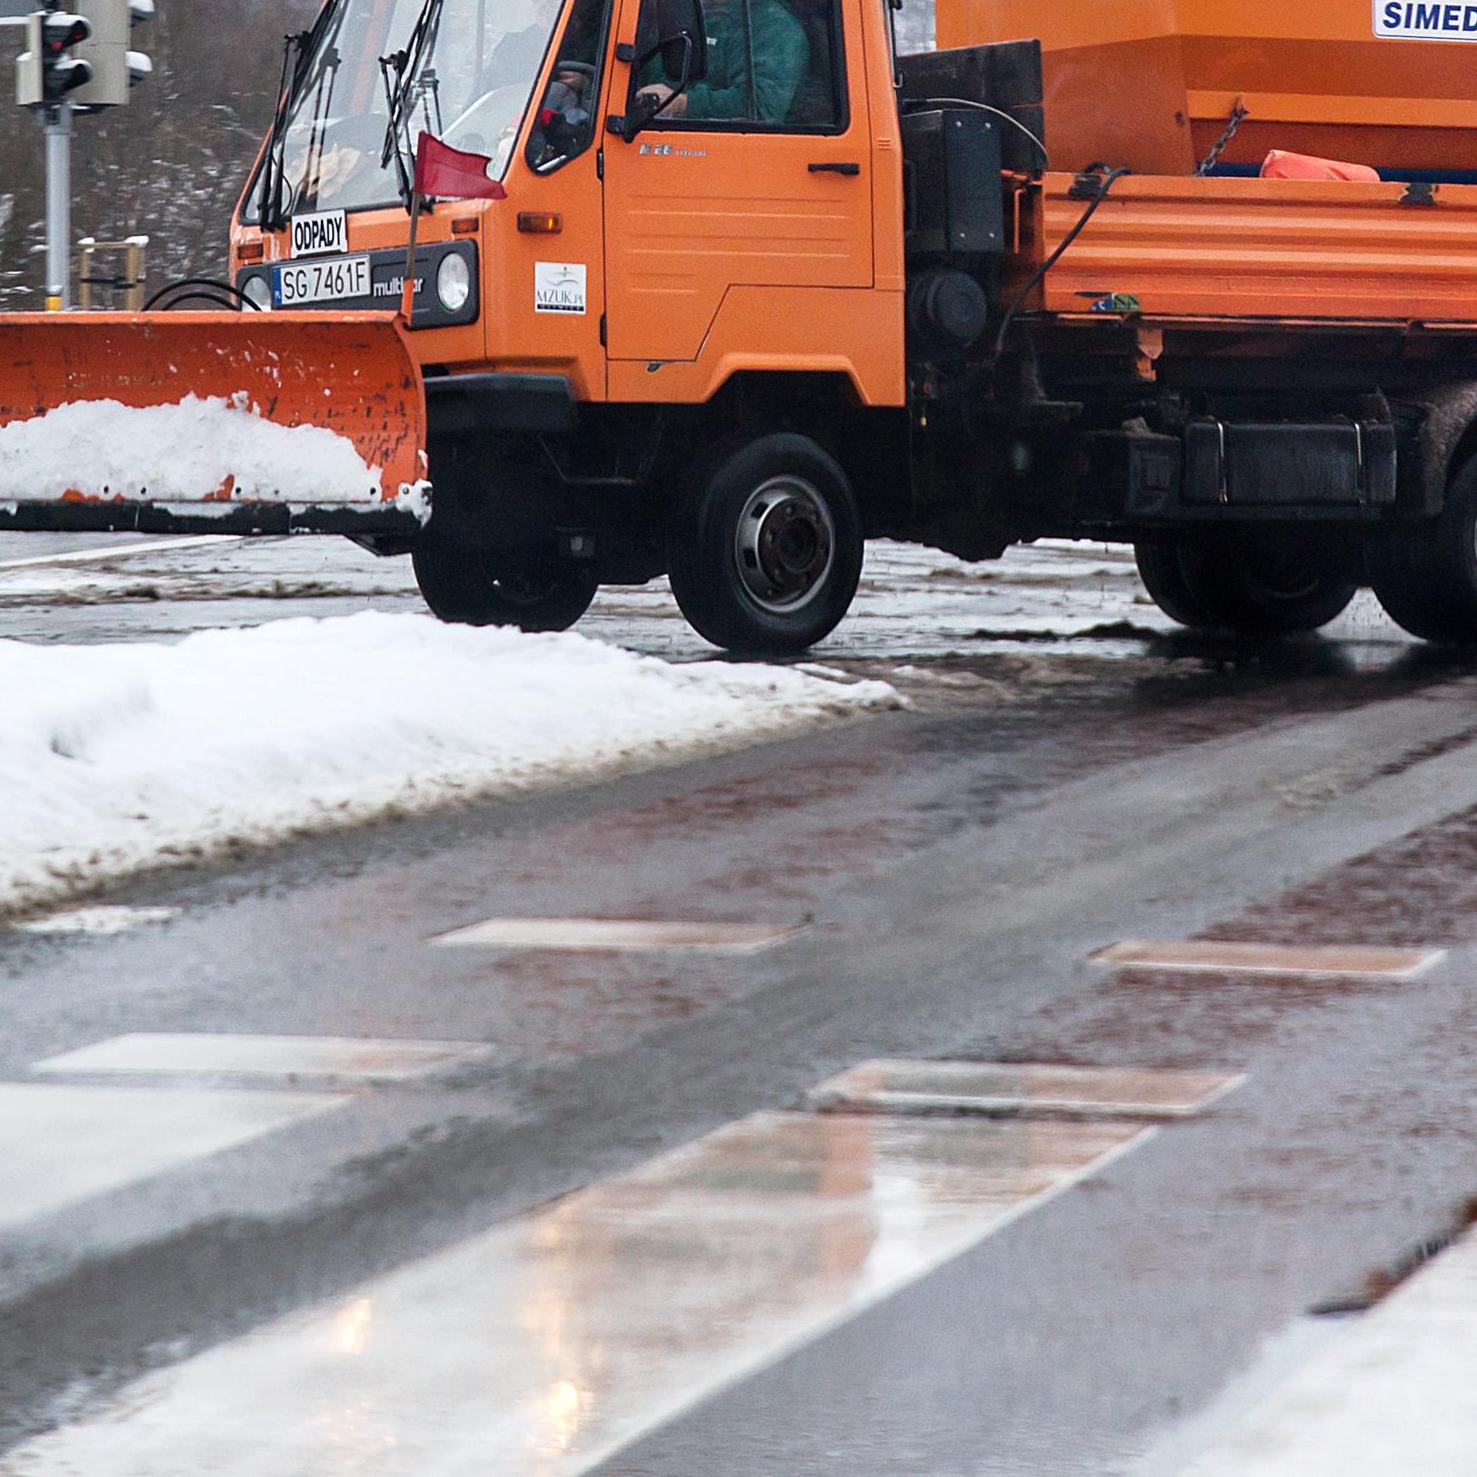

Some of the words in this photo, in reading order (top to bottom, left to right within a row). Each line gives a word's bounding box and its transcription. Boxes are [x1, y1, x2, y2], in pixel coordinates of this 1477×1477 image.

[294, 216, 343, 251] ODPADY
[283, 270, 307, 300] SG
[313, 261, 366, 297] 7461F
[373, 276, 423, 297] multiar
